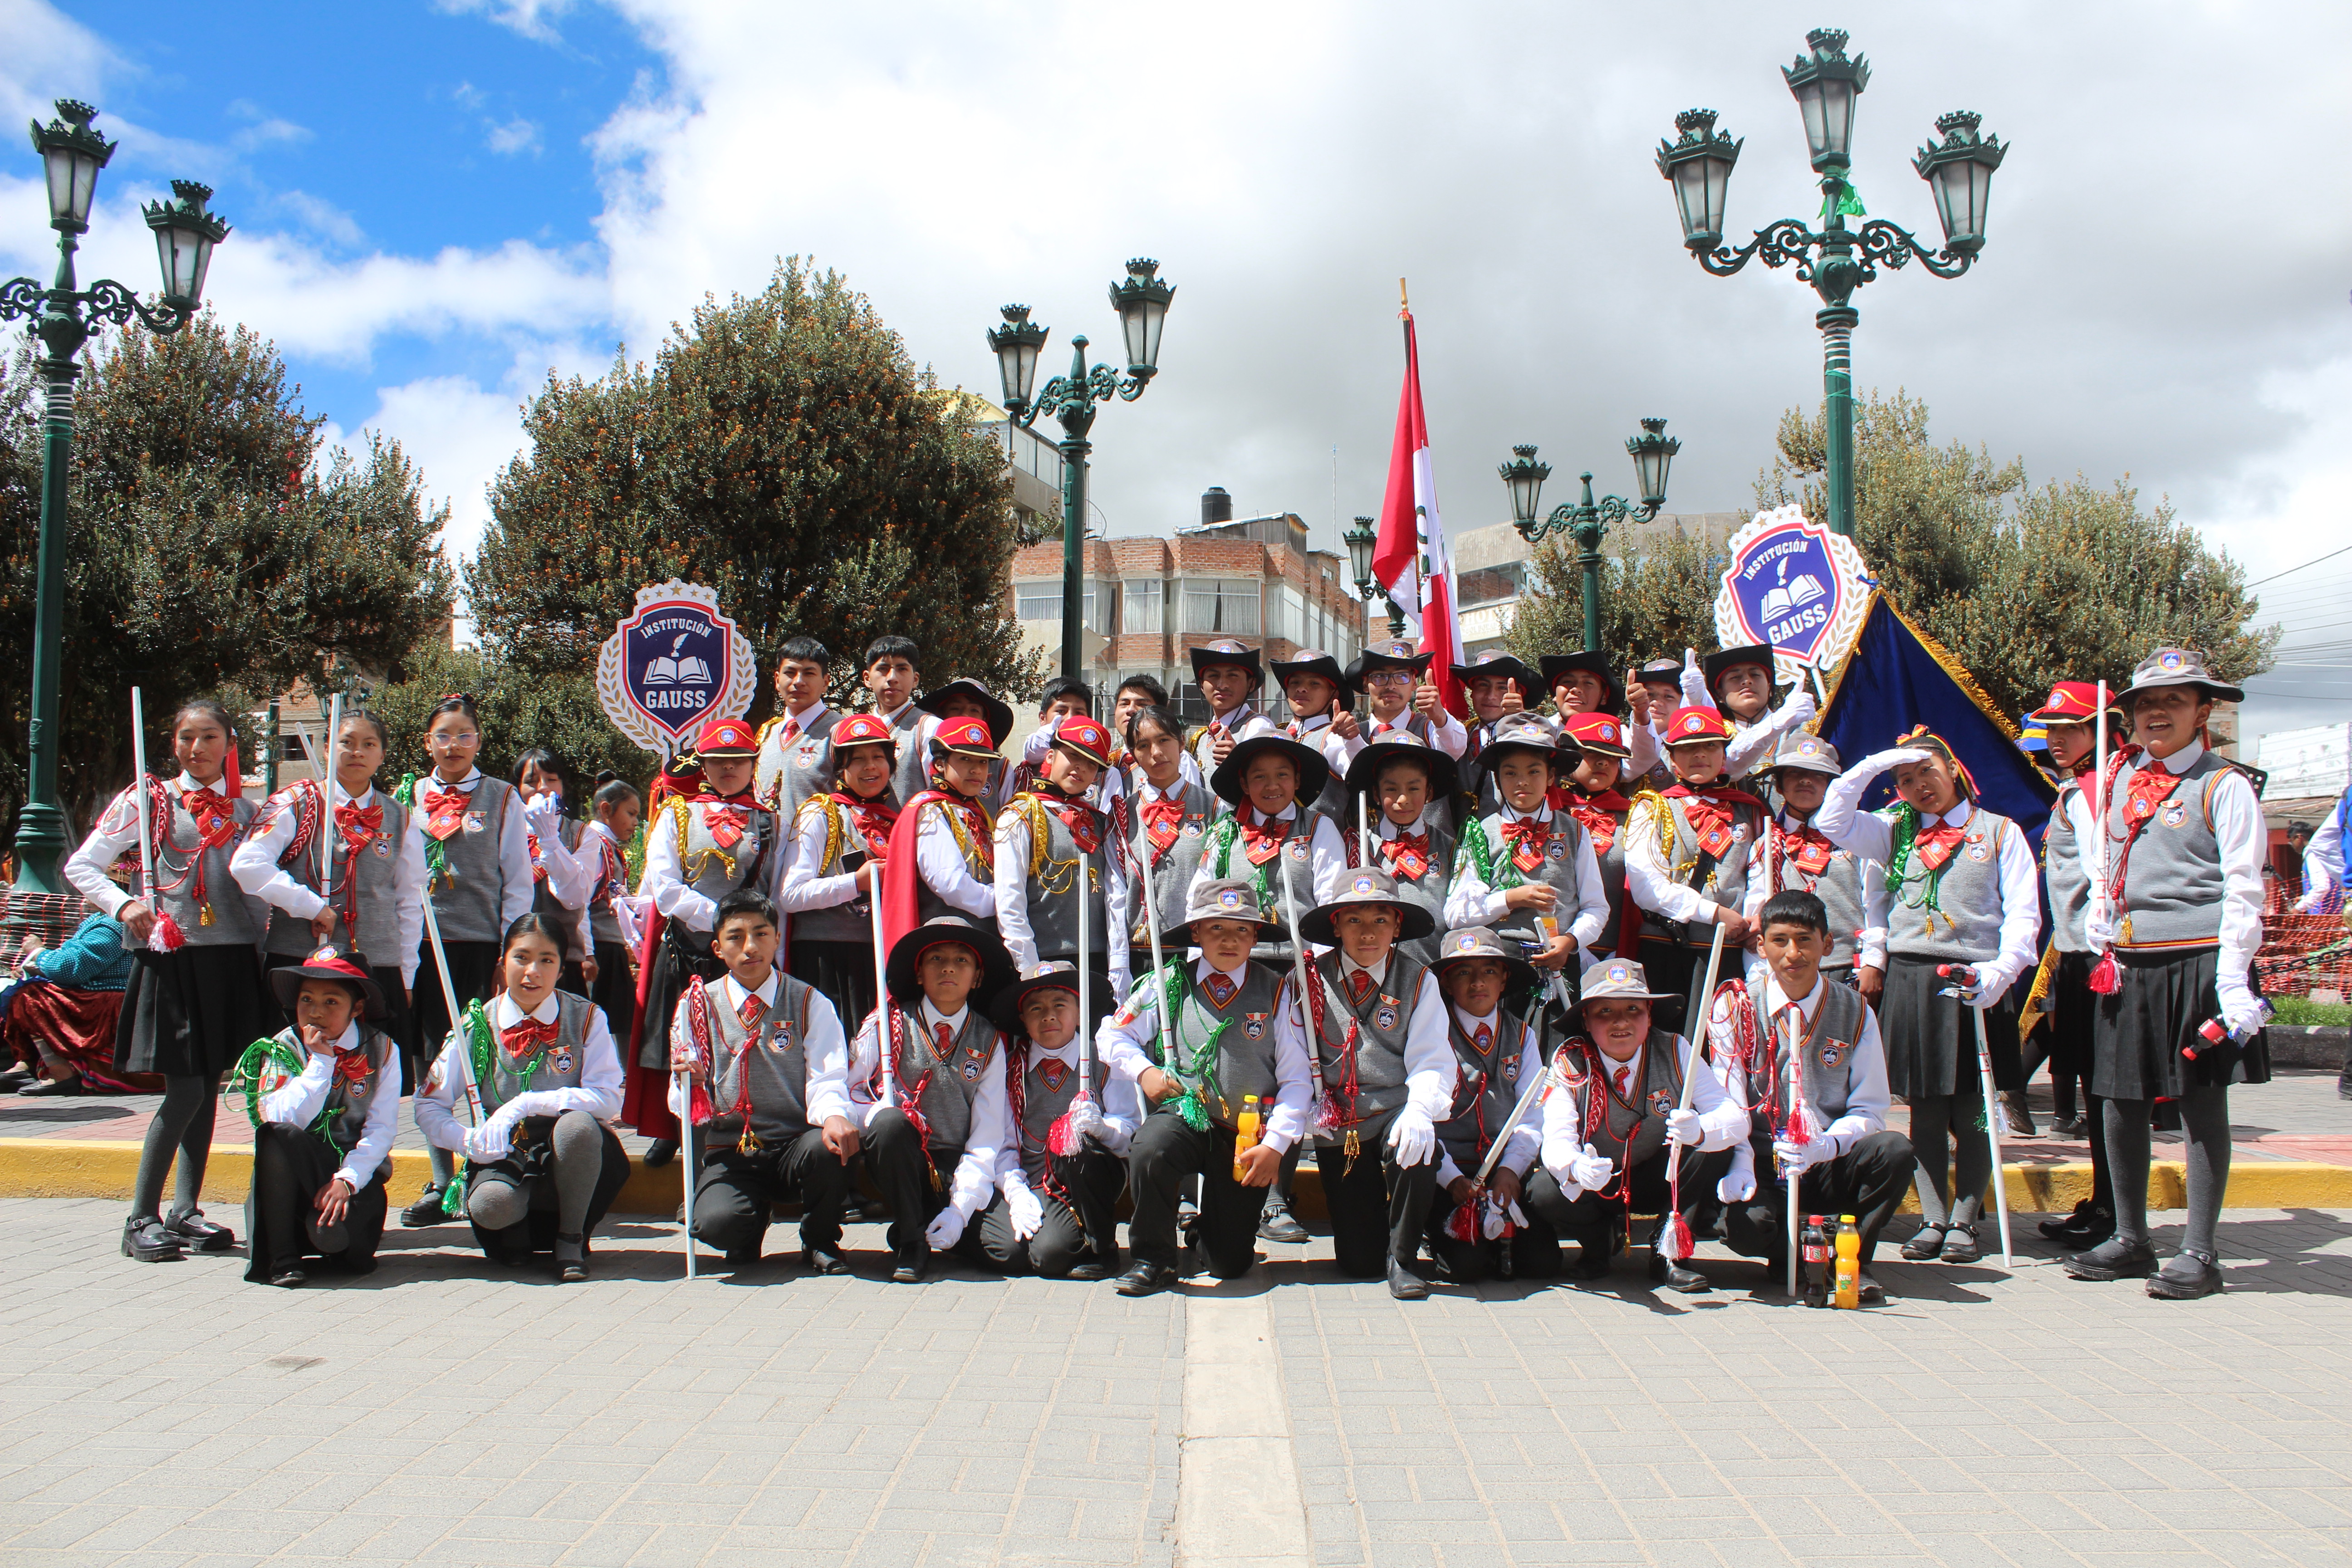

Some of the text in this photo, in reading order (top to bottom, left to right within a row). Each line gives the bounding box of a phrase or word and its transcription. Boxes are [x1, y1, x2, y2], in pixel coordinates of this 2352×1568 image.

[1743, 538, 1809, 581] INSTITUCIÓN
[640, 618, 712, 639] INSTITUCIÓN
[1768, 603, 1828, 645] GAUSS
[645, 690, 706, 709] GAUSS
